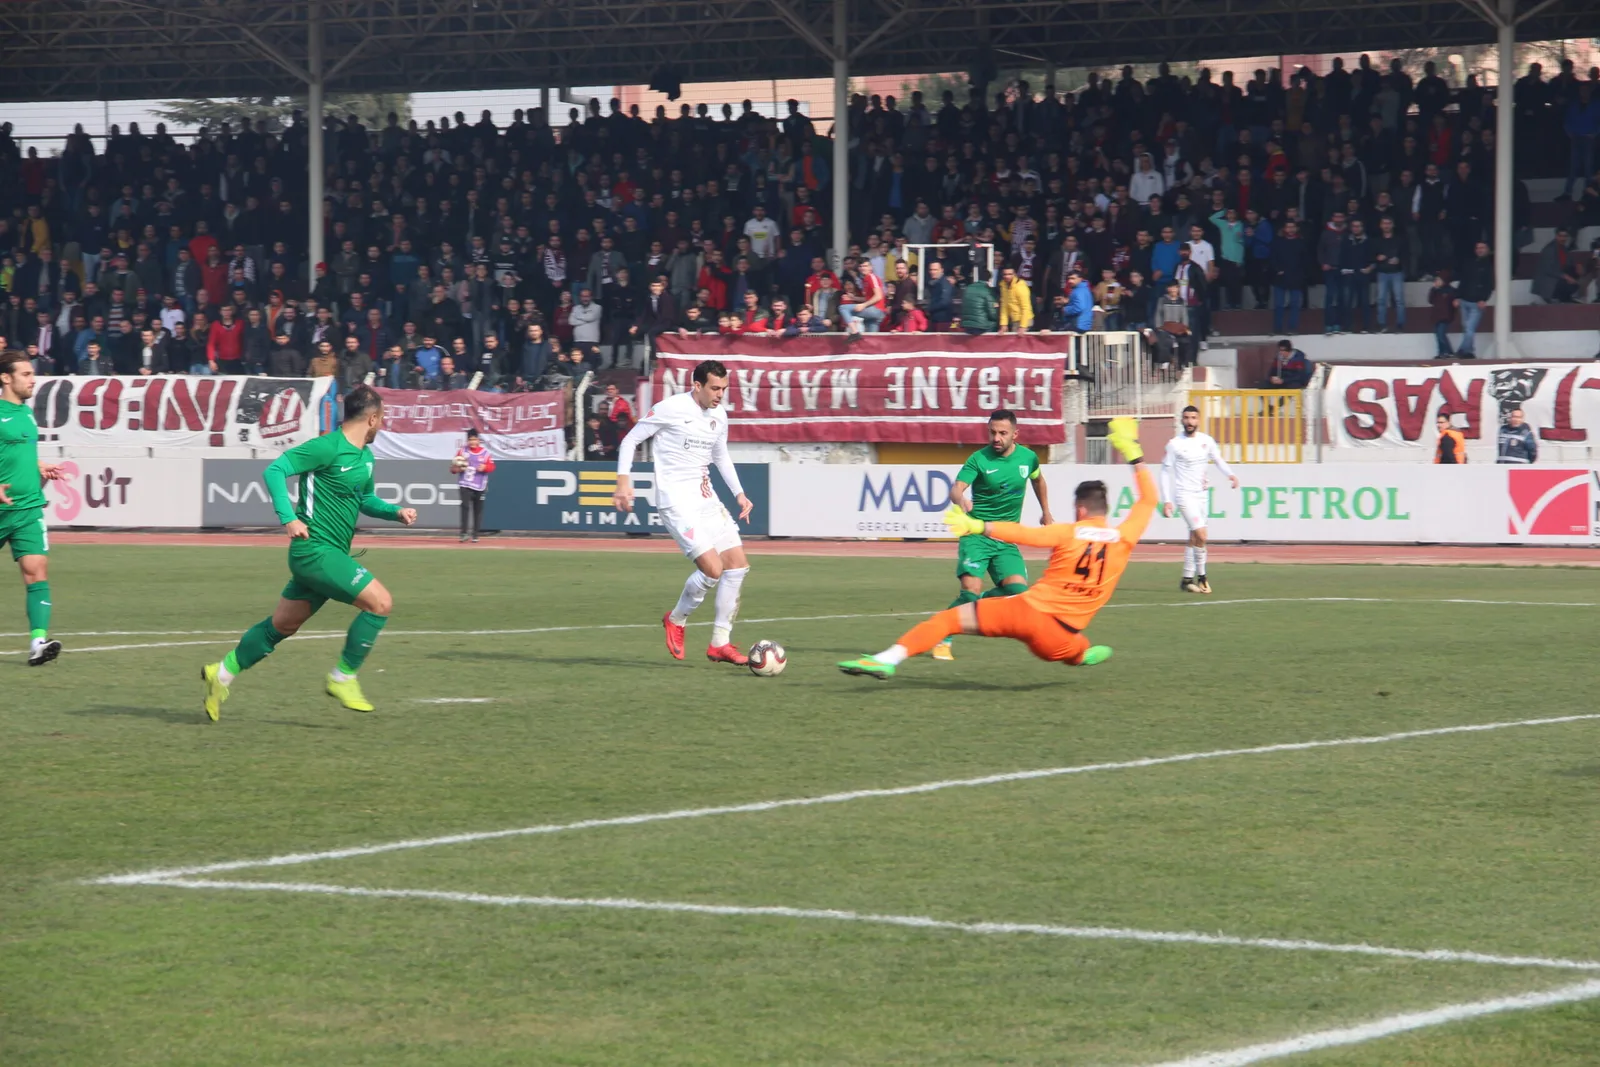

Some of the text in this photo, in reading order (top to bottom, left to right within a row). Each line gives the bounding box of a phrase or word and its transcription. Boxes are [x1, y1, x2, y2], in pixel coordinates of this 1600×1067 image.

[661, 366, 1054, 413] EFSANE MARATN
[858, 469, 953, 512] MAD
[1242, 485, 1410, 520] PETROL
[915, 521, 949, 533] LEZZ
[1074, 541, 1107, 586] 41
